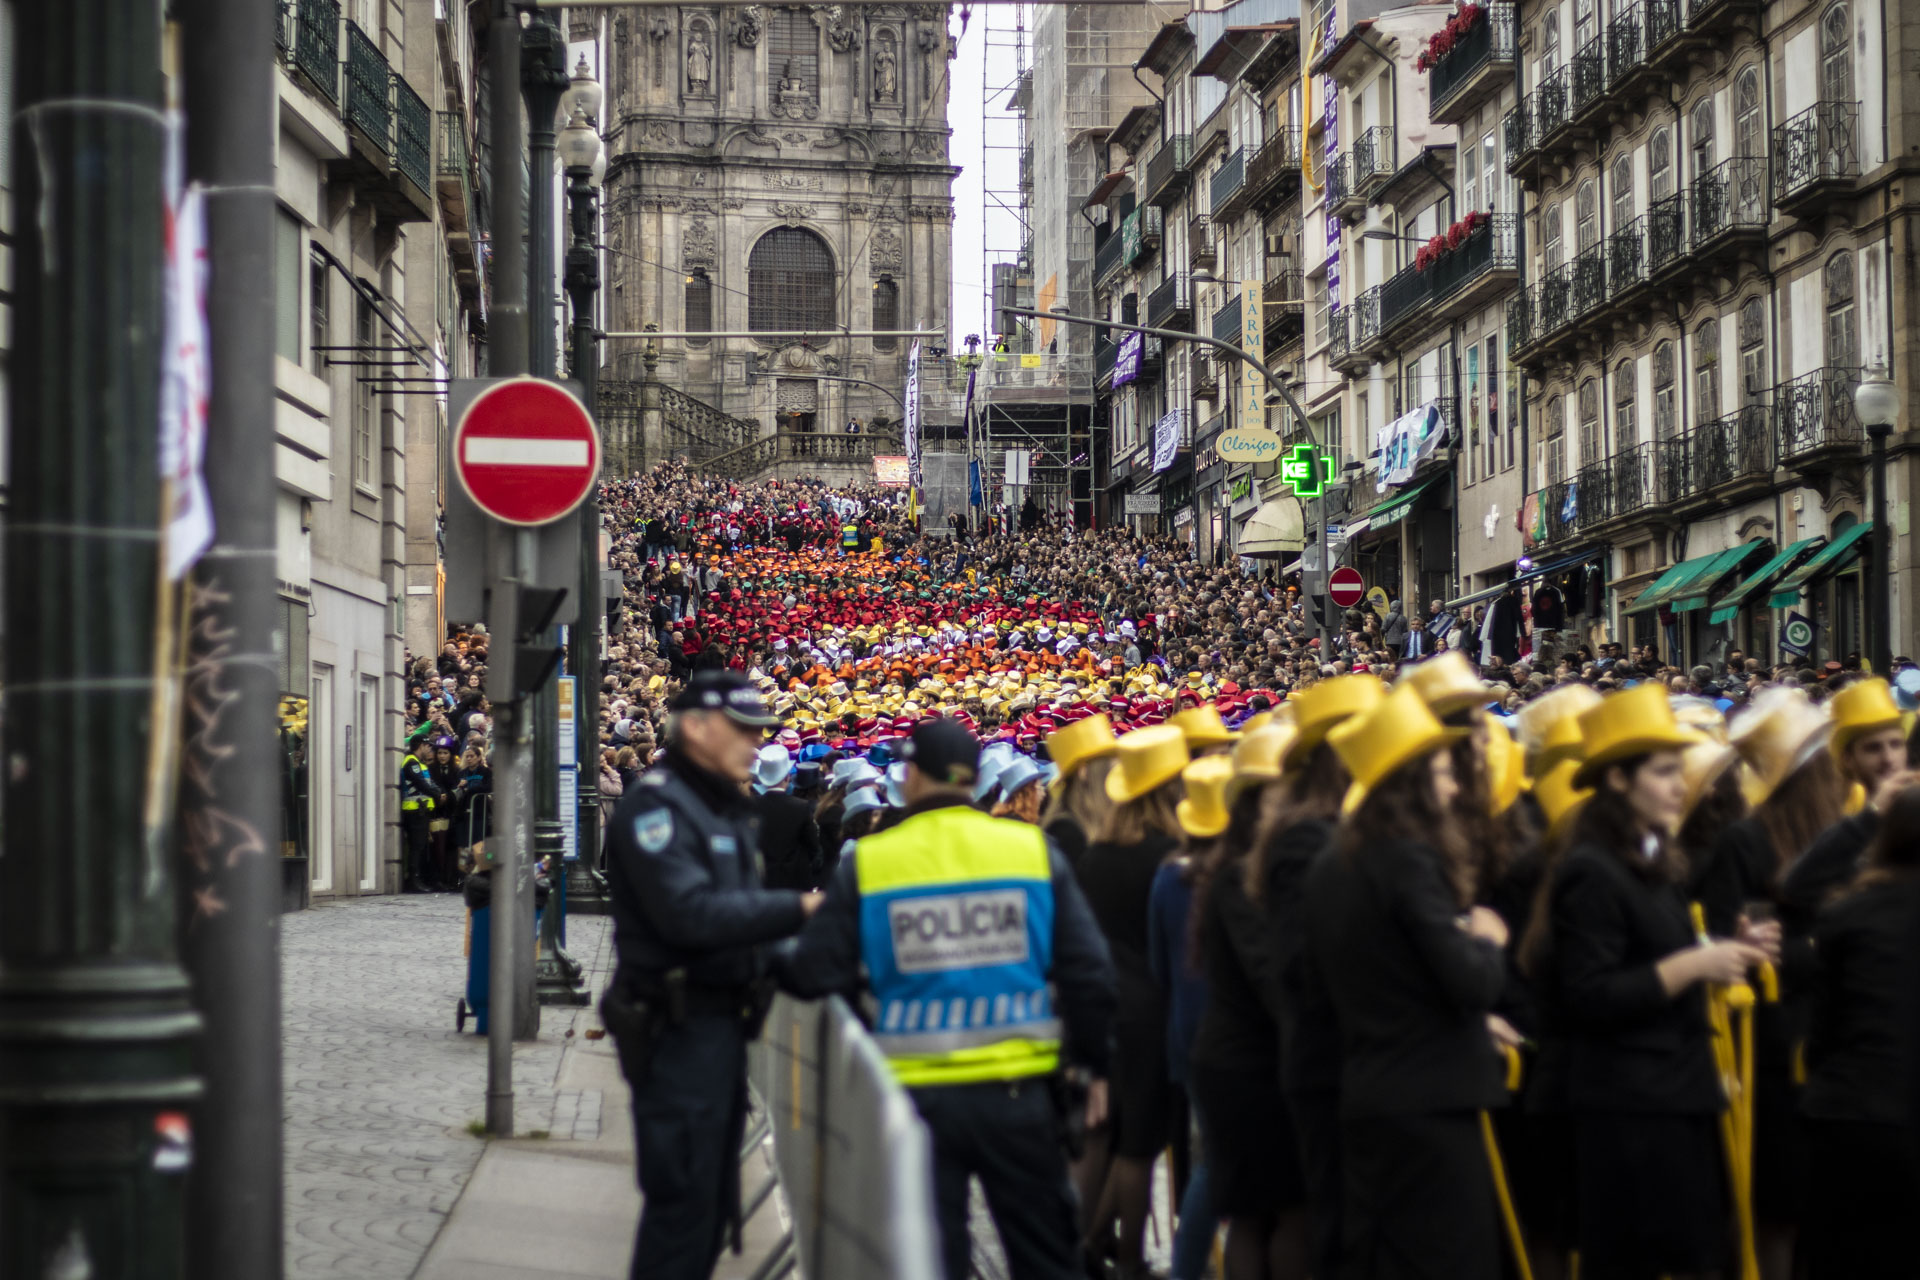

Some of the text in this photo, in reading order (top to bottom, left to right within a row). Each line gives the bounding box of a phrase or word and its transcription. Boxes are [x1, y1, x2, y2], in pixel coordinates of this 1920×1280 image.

[1222, 435, 1277, 457] Clérigos
[1283, 462, 1308, 478] KE
[894, 897, 1021, 944] POLÍCIA
